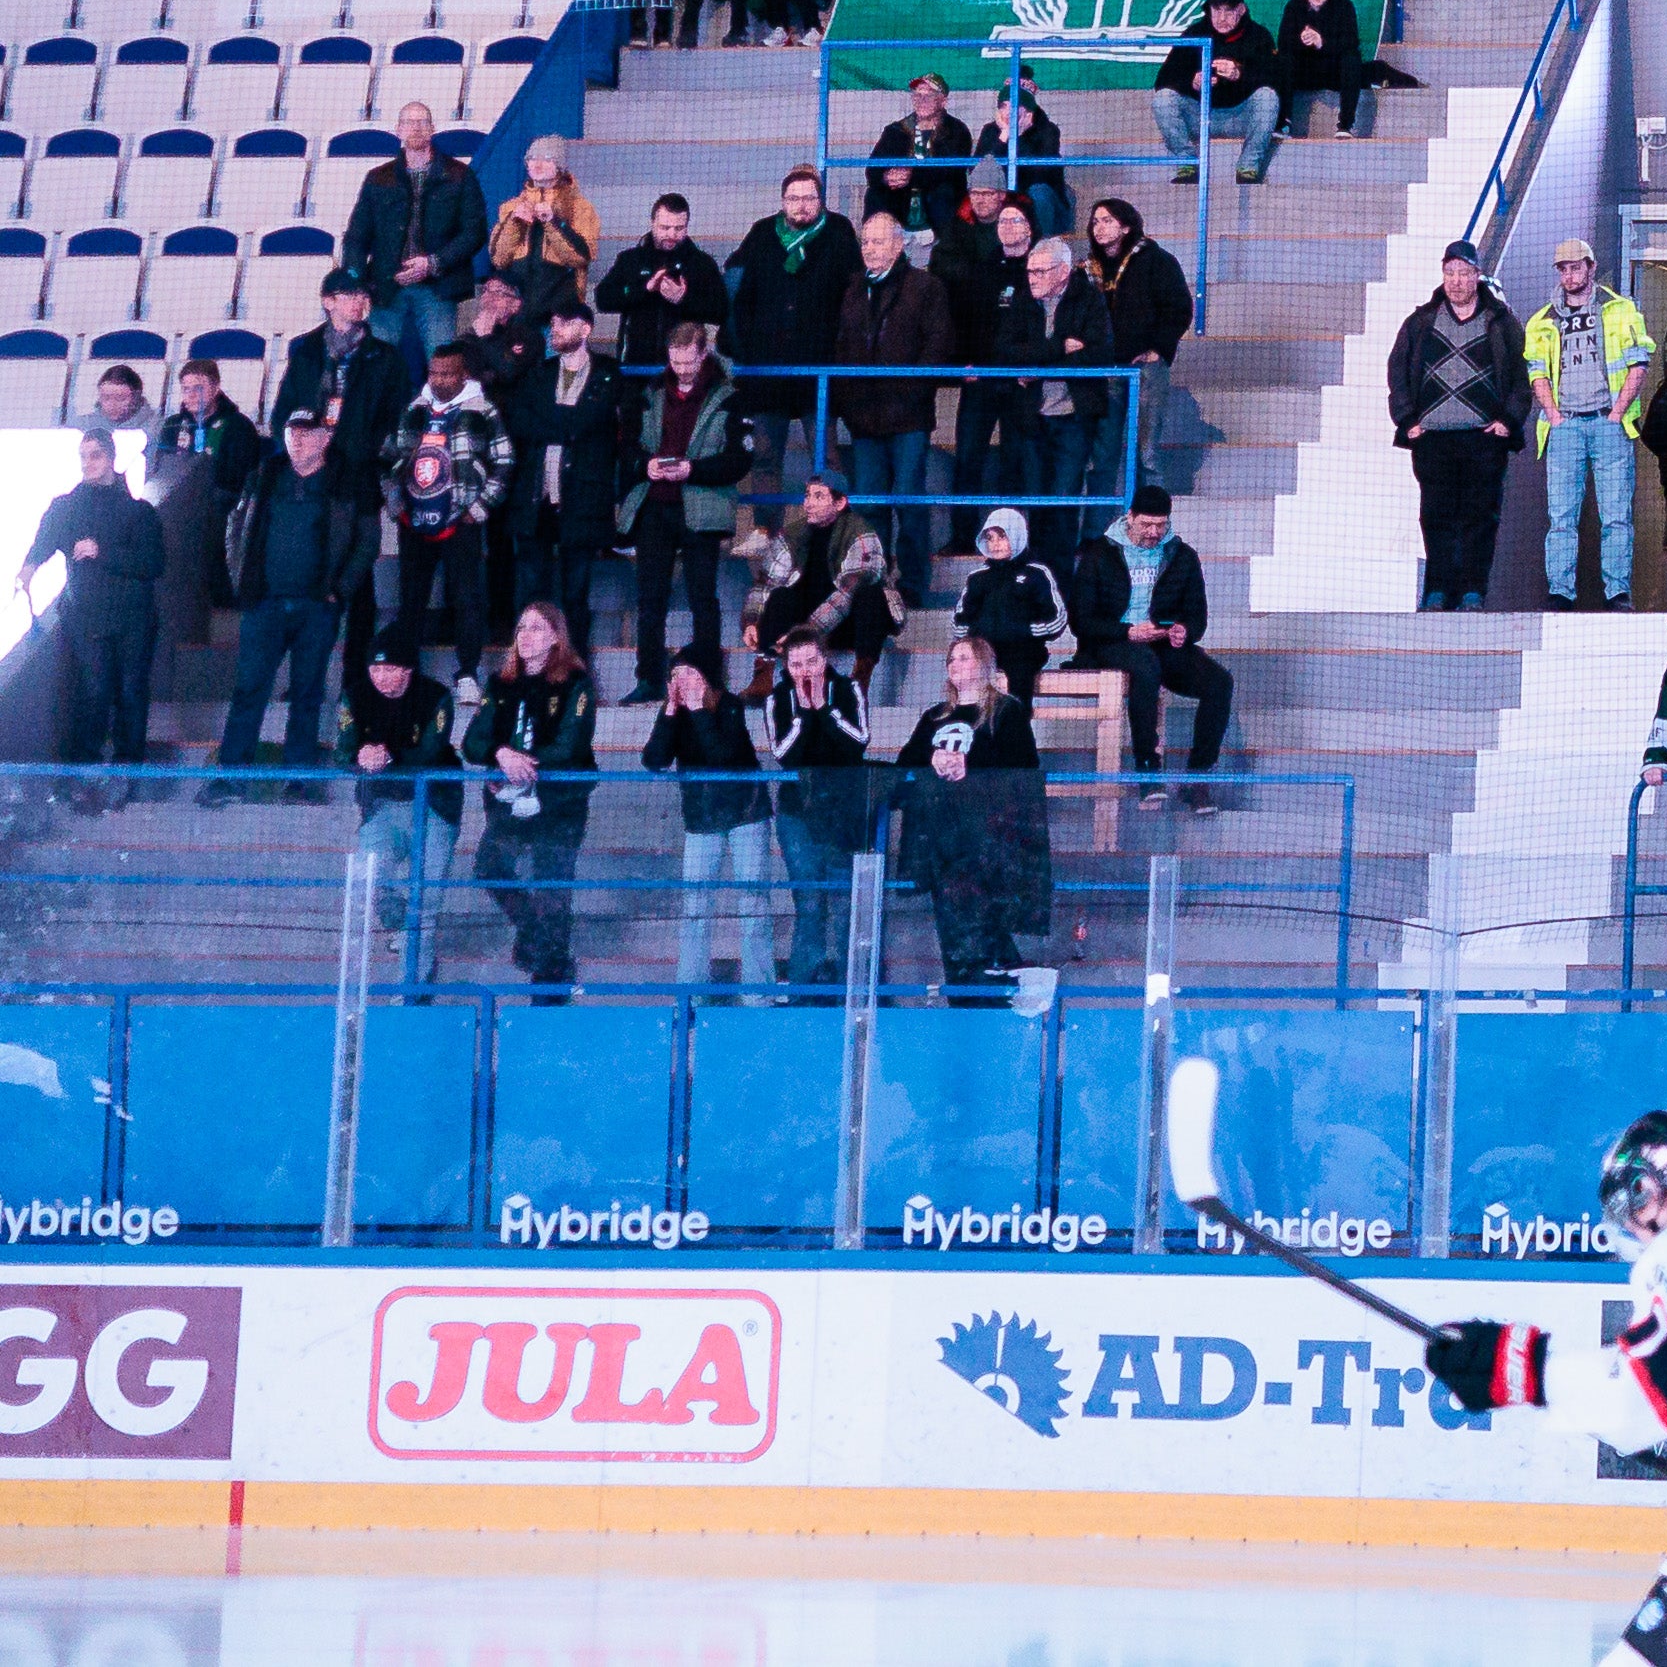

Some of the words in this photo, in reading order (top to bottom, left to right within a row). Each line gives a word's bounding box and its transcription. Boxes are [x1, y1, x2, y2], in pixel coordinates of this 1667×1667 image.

[0, 1198, 181, 1246] ybridge
[500, 1193, 710, 1251] Hybridge
[903, 1194, 1108, 1253] Hybridge
[386, 1321, 762, 1427] JULA
